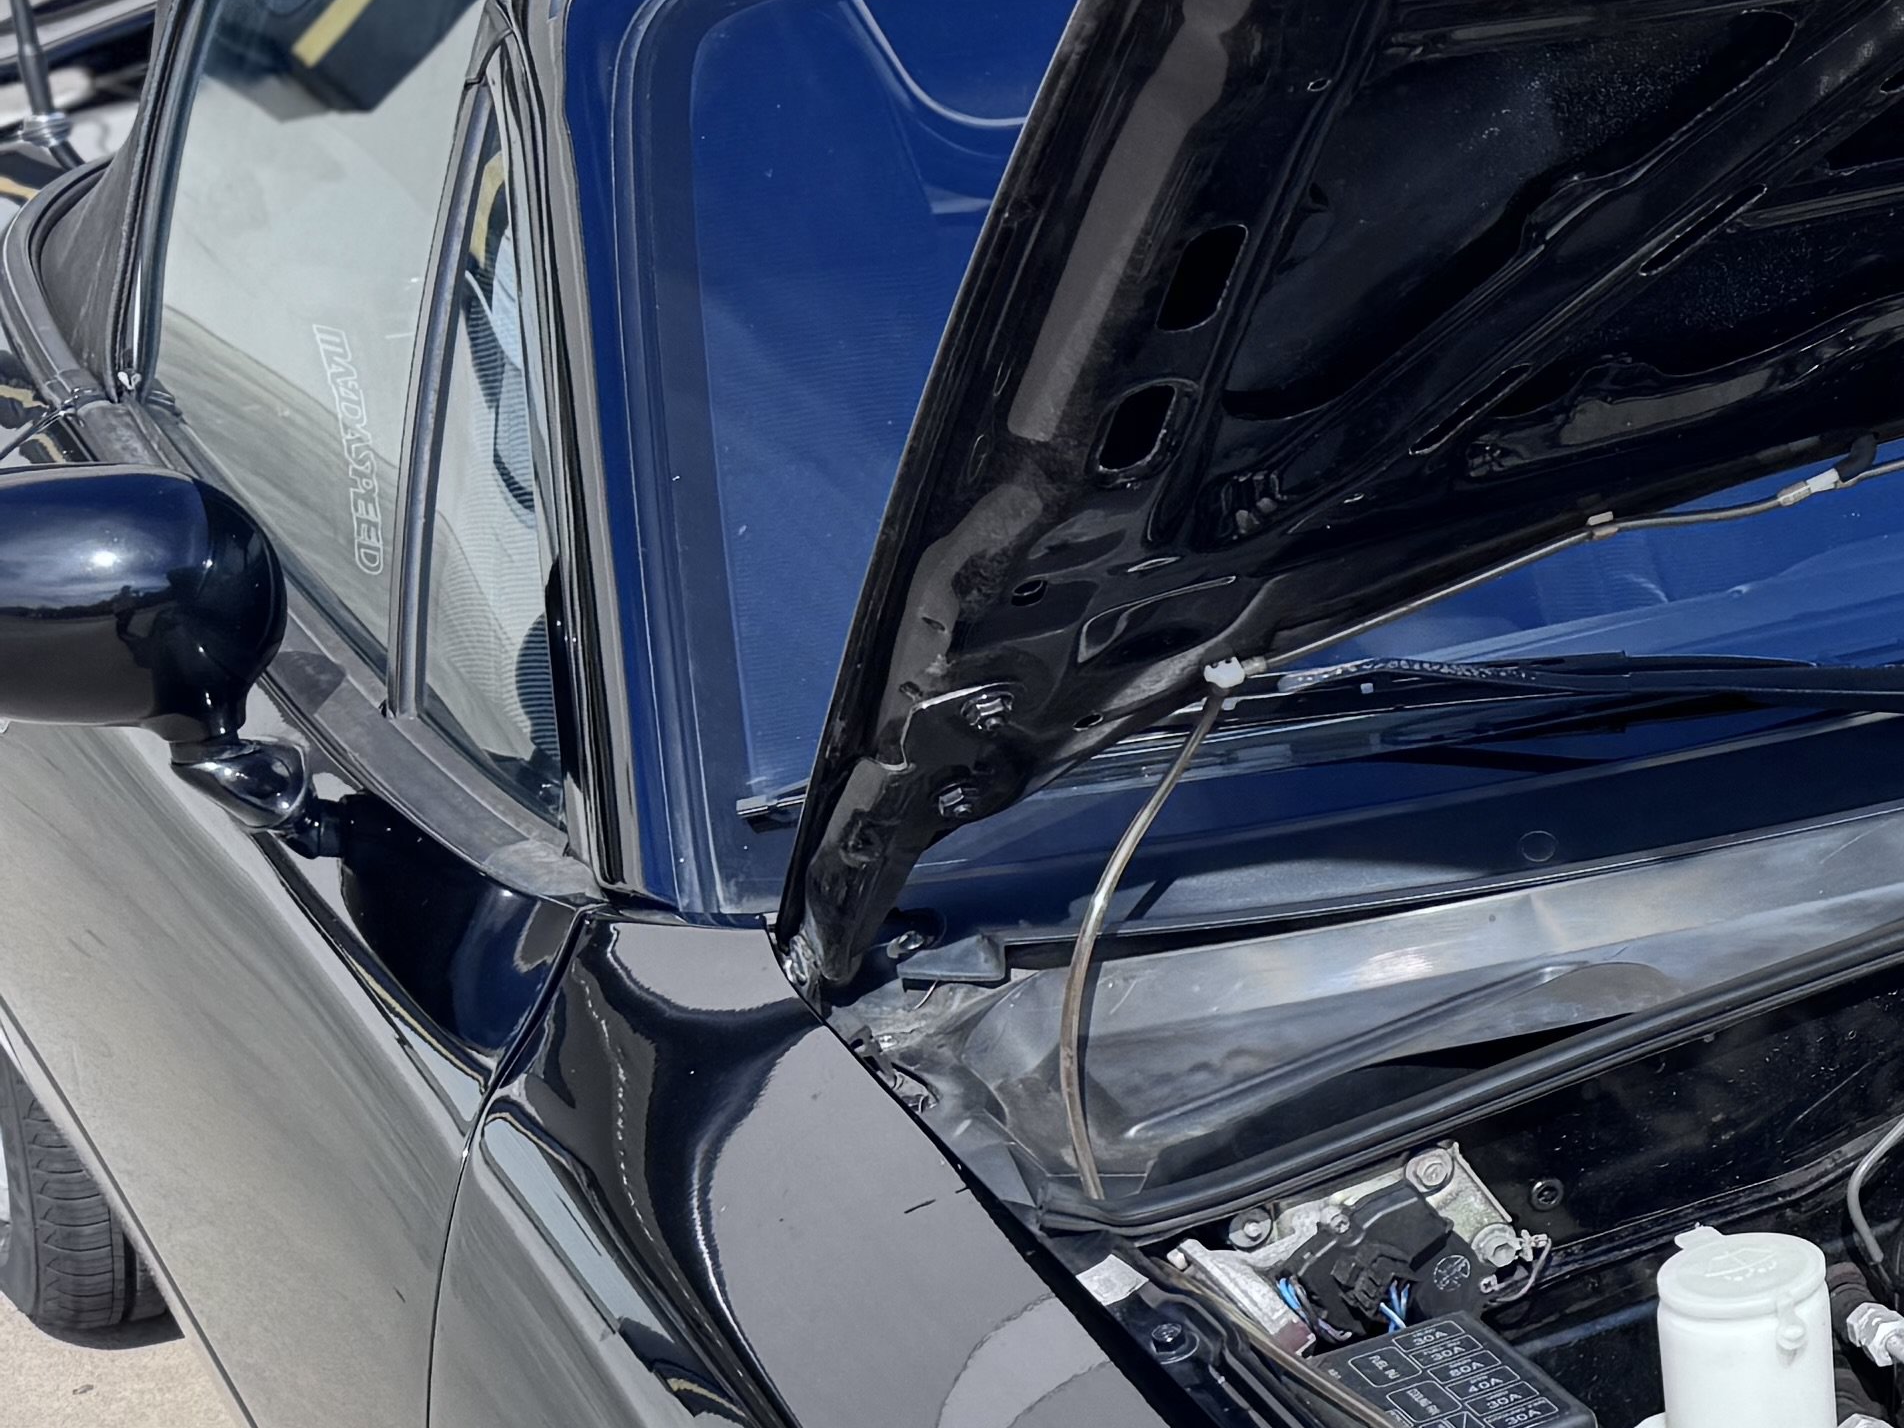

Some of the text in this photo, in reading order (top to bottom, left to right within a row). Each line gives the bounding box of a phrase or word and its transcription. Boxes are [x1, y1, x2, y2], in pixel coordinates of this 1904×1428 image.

[1409, 1329, 1449, 1346] 30A
[1428, 1344, 1466, 1361] 30A
[1445, 1359, 1485, 1377] 80A
[1464, 1375, 1504, 1393] 40A
[1484, 1391, 1524, 1409] 30A
[1502, 1407, 1542, 1425] 30A
